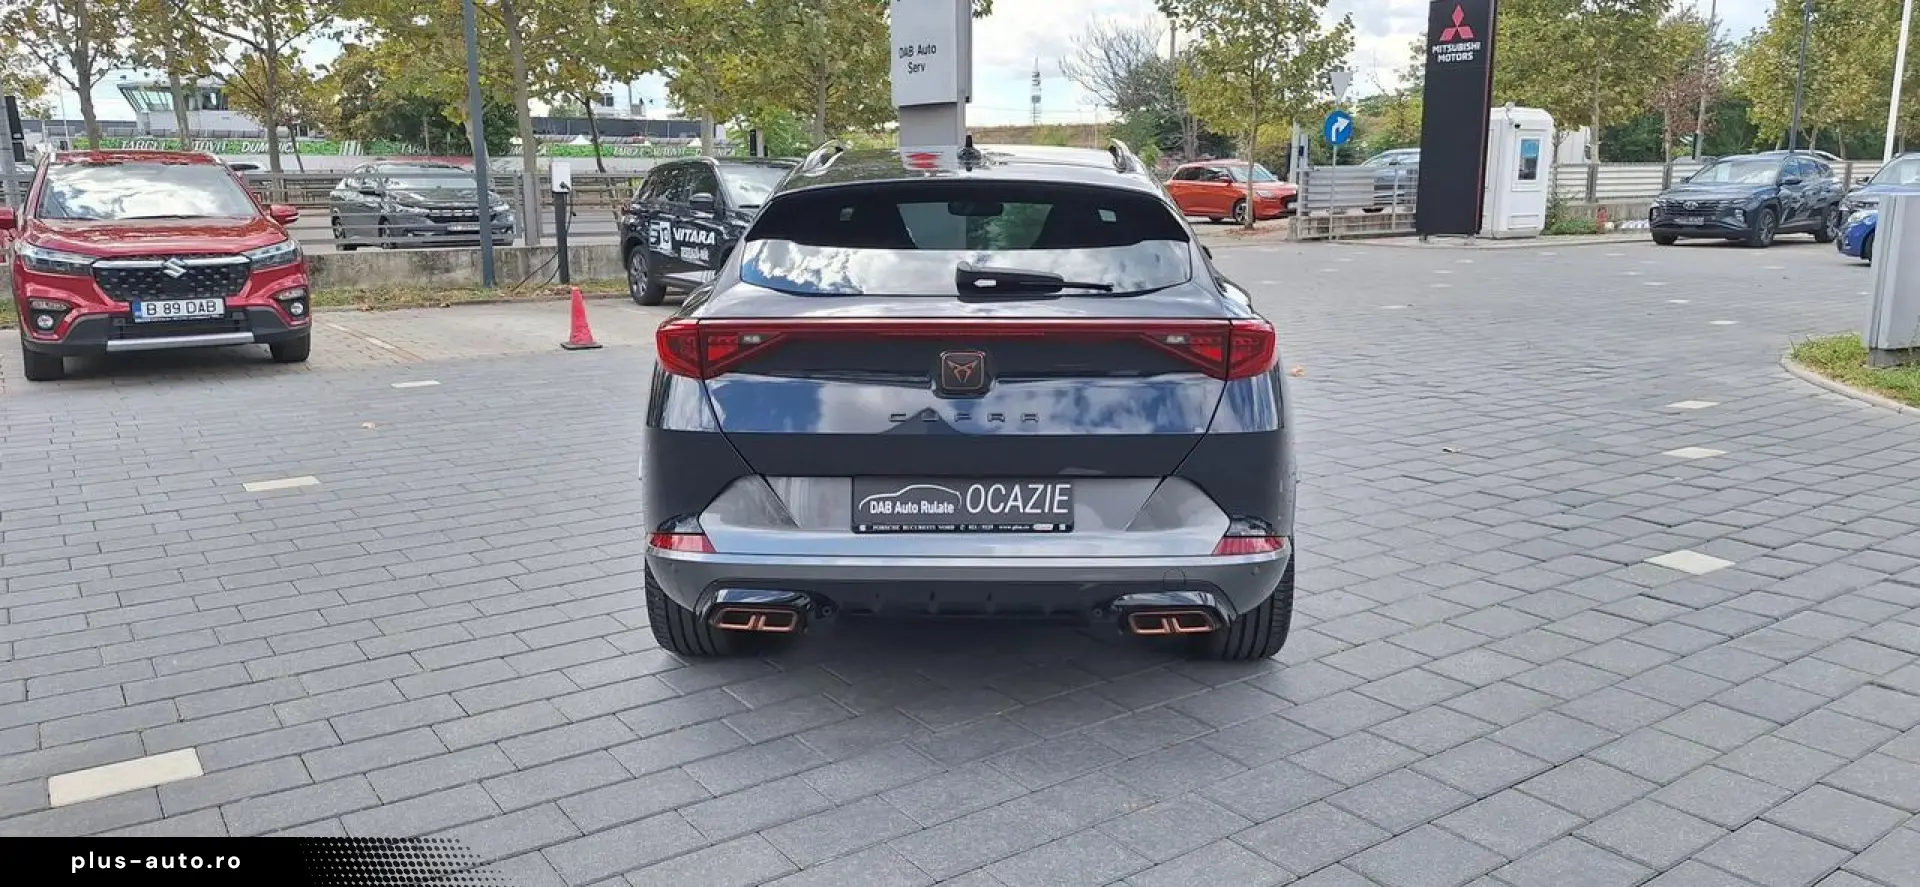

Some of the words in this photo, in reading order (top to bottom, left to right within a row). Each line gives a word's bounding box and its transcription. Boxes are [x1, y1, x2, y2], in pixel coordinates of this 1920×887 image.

[899, 45, 914, 59] DAB
[917, 44, 937, 56] Auto
[1432, 41, 1481, 54] MITSUBISHI
[1437, 51, 1474, 63] MOTORS
[907, 61, 926, 74] Serv
[673, 227, 715, 246] VITARA
[146, 303, 157, 316] B
[163, 302, 181, 315] 89
[186, 300, 217, 314] DAB
[889, 412, 1040, 424] CUPRA
[965, 483, 1072, 514] OCAZIE
[869, 500, 892, 514] DAB
[894, 501, 919, 514] Auto
[920, 500, 955, 514] Rulate
